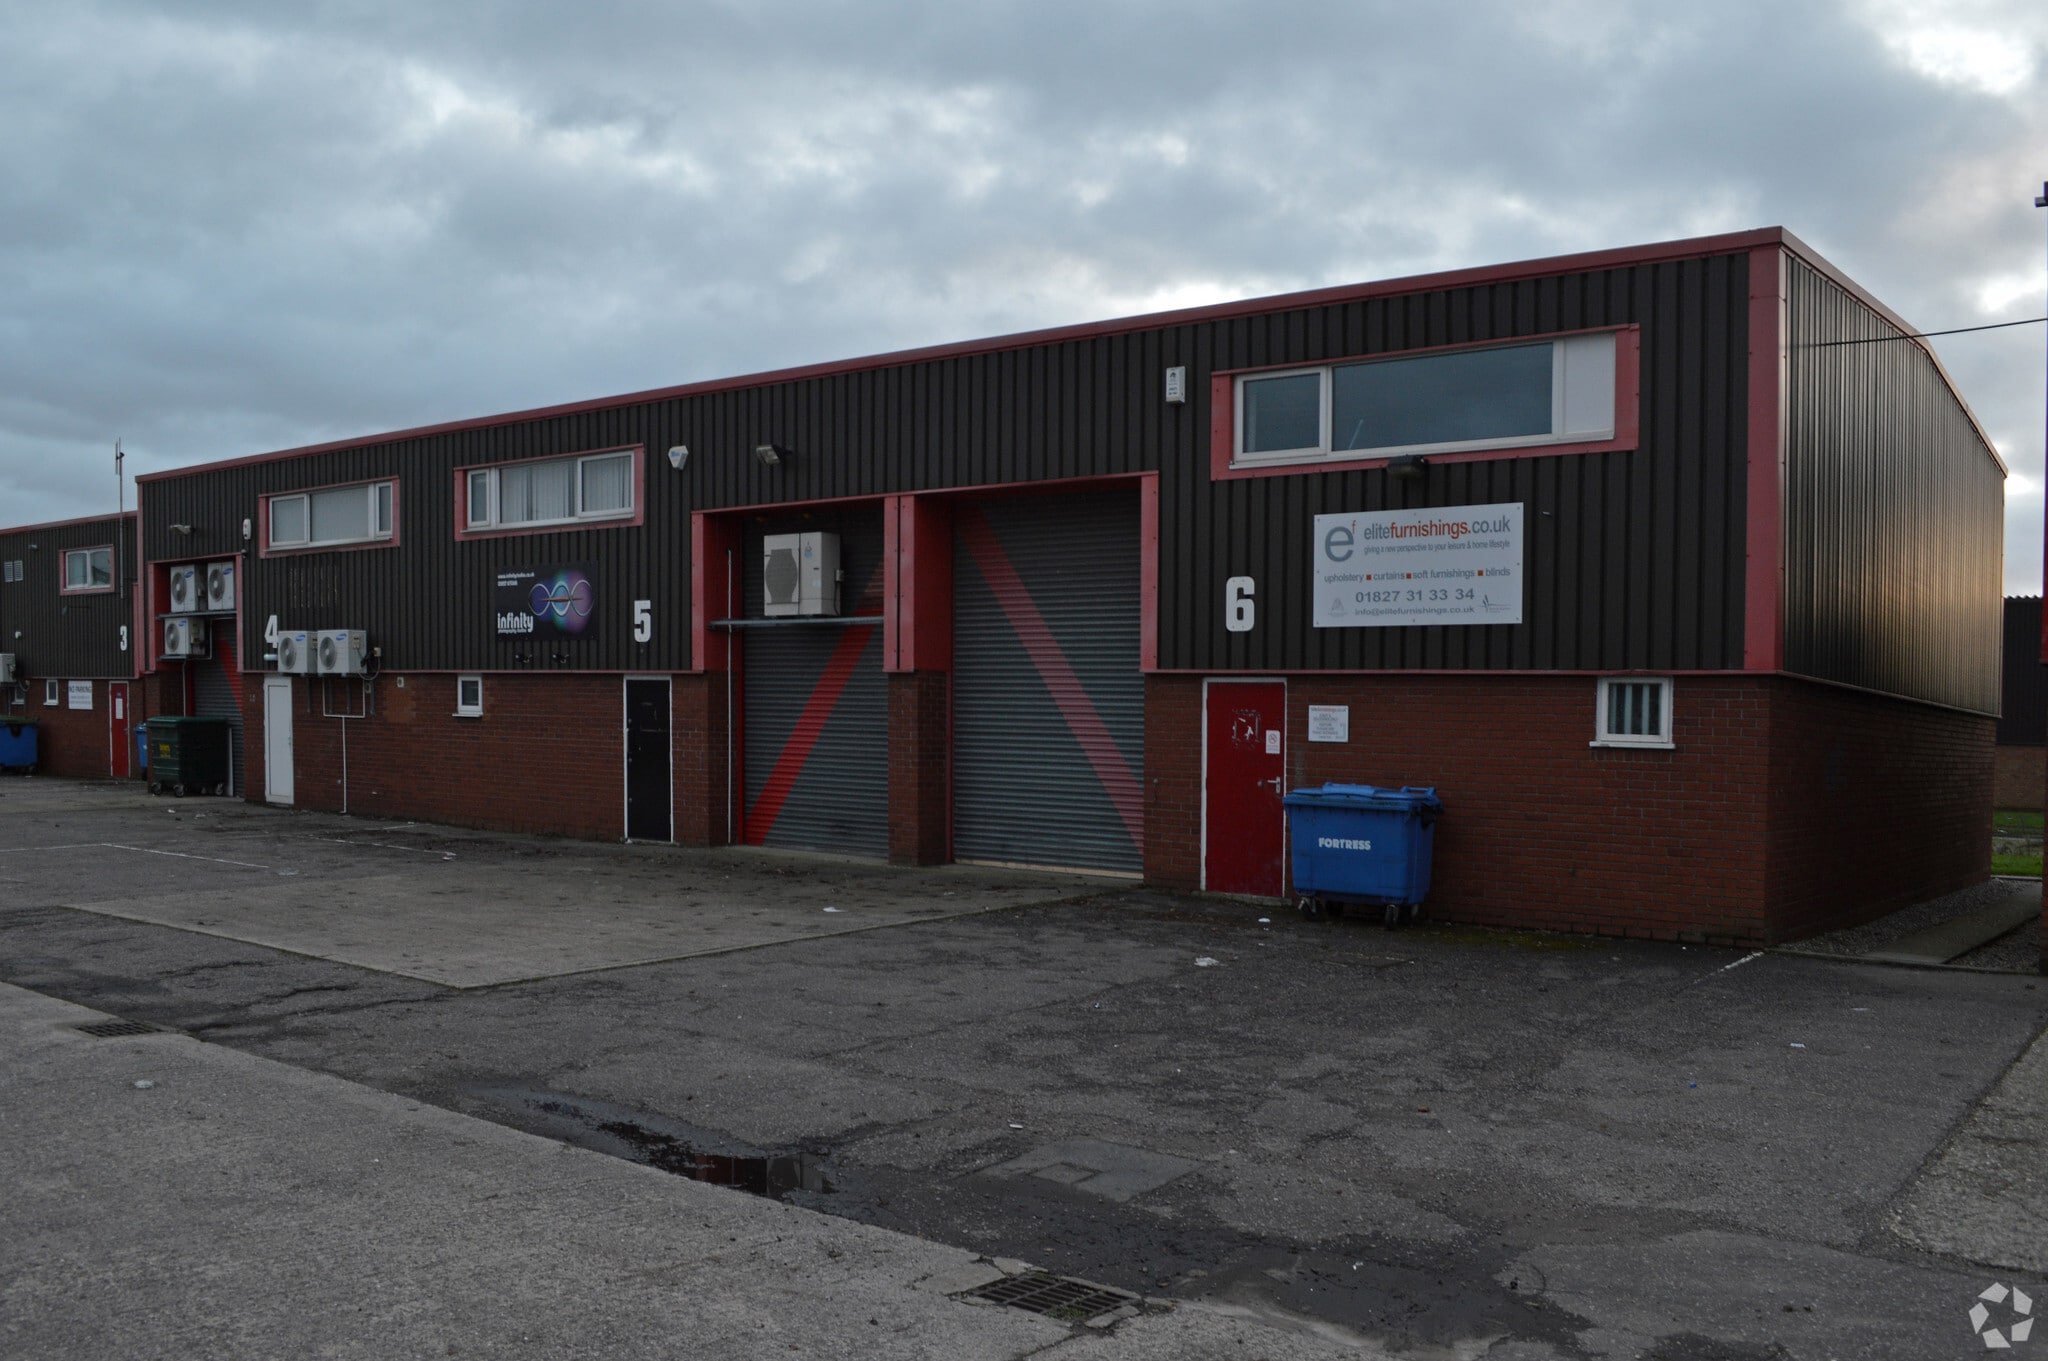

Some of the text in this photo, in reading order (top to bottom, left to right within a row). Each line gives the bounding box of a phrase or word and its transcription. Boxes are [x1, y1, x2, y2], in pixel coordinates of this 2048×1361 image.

[1364, 515, 1511, 540] elitefurnishings.co.uk
[1324, 566, 1511, 584] upholstery curtains soft furnishings blinds
[1226, 576, 1255, 632] 6
[1355, 588, 1475, 603] 01827 31 33 34
[264, 614, 279, 649] 4
[497, 612, 534, 633] infinity
[634, 600, 652, 642] 5
[120, 625, 128, 651] 3
[1319, 837, 1372, 851] FORTRESS
